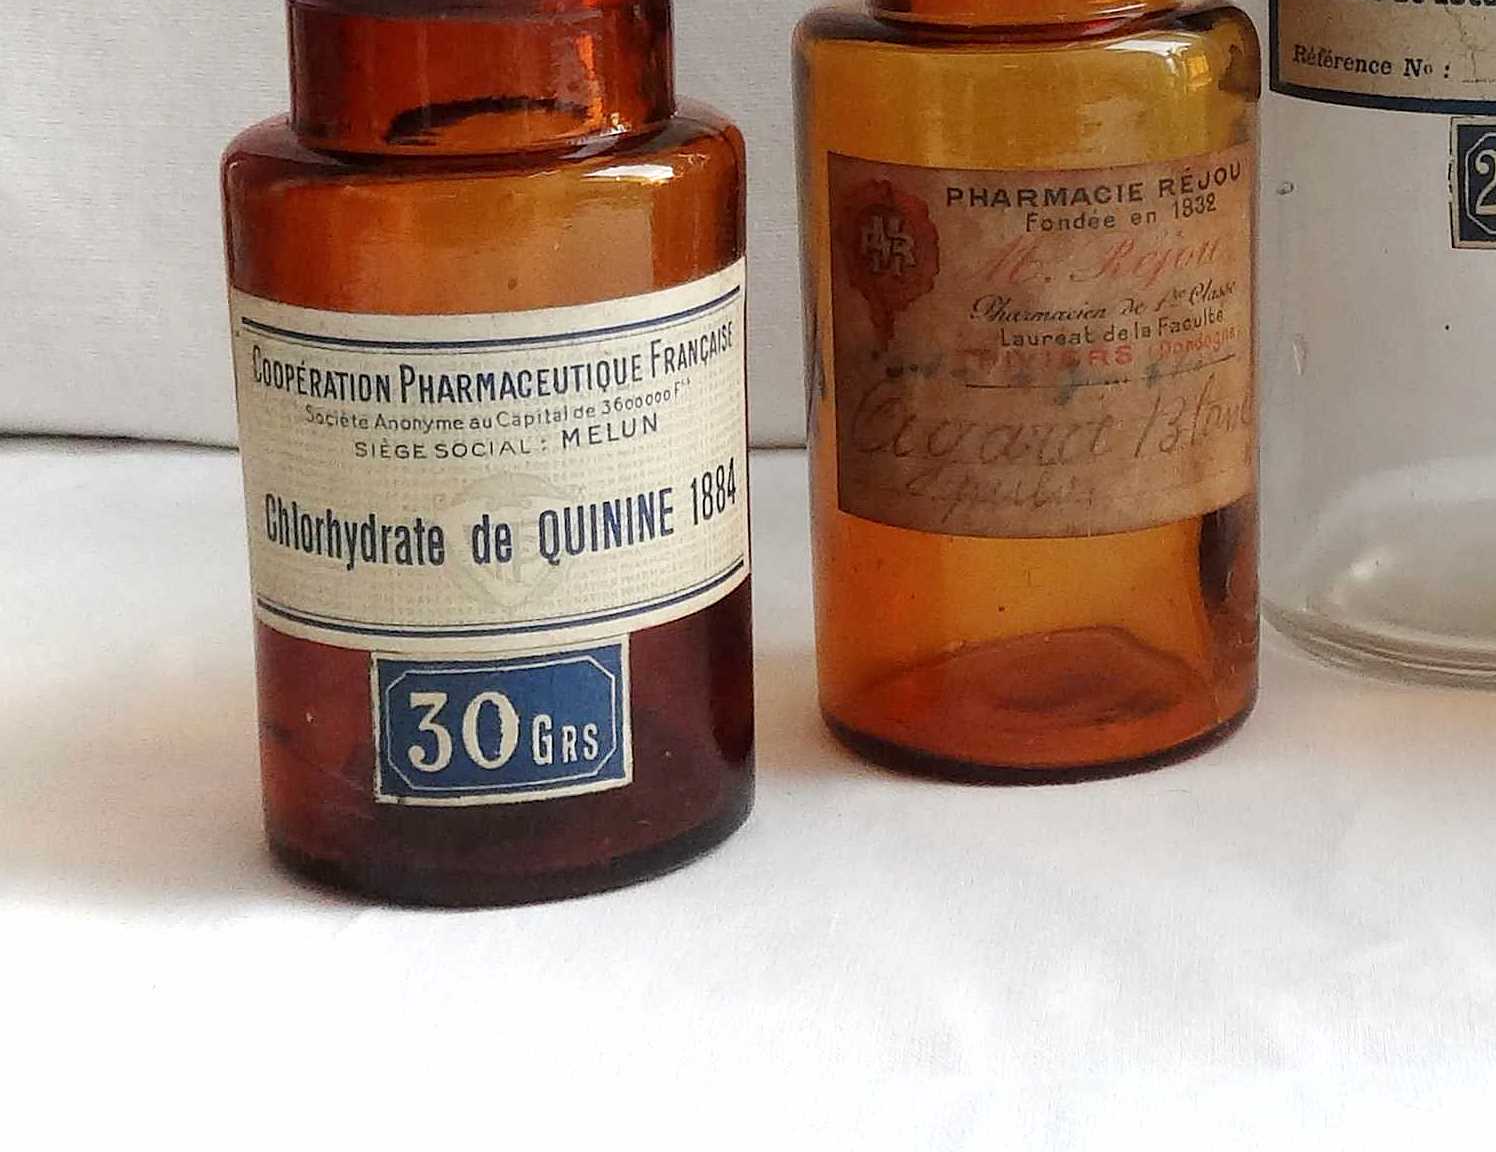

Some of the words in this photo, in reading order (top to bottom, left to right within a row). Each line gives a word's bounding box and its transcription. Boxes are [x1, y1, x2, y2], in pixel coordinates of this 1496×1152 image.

[1292, 44, 1392, 76] Référence
[946, 181, 1143, 208] PHARMACIE
[1158, 160, 1241, 198] RÉJOU
[1026, 210, 1116, 233] Fondée
[1130, 211, 1157, 226] en
[1172, 192, 1216, 220] 1832
[1103, 324, 1128, 343] de
[1134, 321, 1151, 340] la
[252, 345, 391, 404] COOPÉRATION
[399, 354, 642, 404] PHARMACEUTIQUE
[650, 320, 733, 379] FRANÇAISE
[354, 437, 427, 460] SIÈGE
[434, 438, 530, 460] SOCIAL
[562, 412, 659, 449] MELUN
[375, 413, 464, 434] Anonyme
[469, 420, 493, 428] au
[497, 403, 568, 429] Capital
[573, 404, 596, 419] de
[265, 493, 445, 571] Chlorhydrate
[472, 514, 513, 566] de
[538, 487, 675, 567] QUININE
[690, 456, 738, 526] 1884
[406, 690, 520, 774] 30
